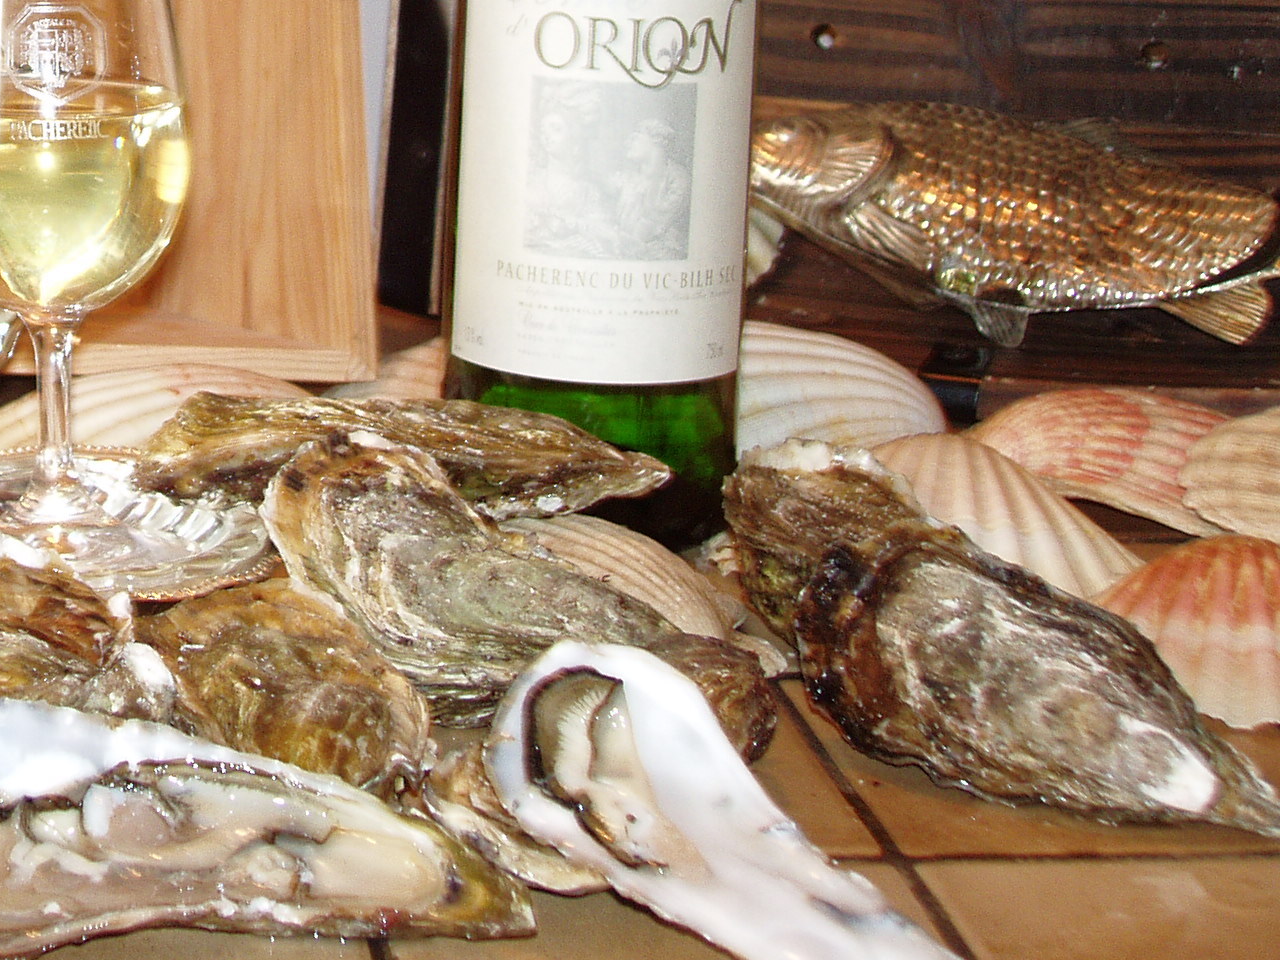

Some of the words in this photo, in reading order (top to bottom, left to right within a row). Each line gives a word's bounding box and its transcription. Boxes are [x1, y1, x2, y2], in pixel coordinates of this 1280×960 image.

[496, 259, 599, 289] PACHERENC
[609, 271, 633, 289] DU
[718, 264, 737, 285] SEC
